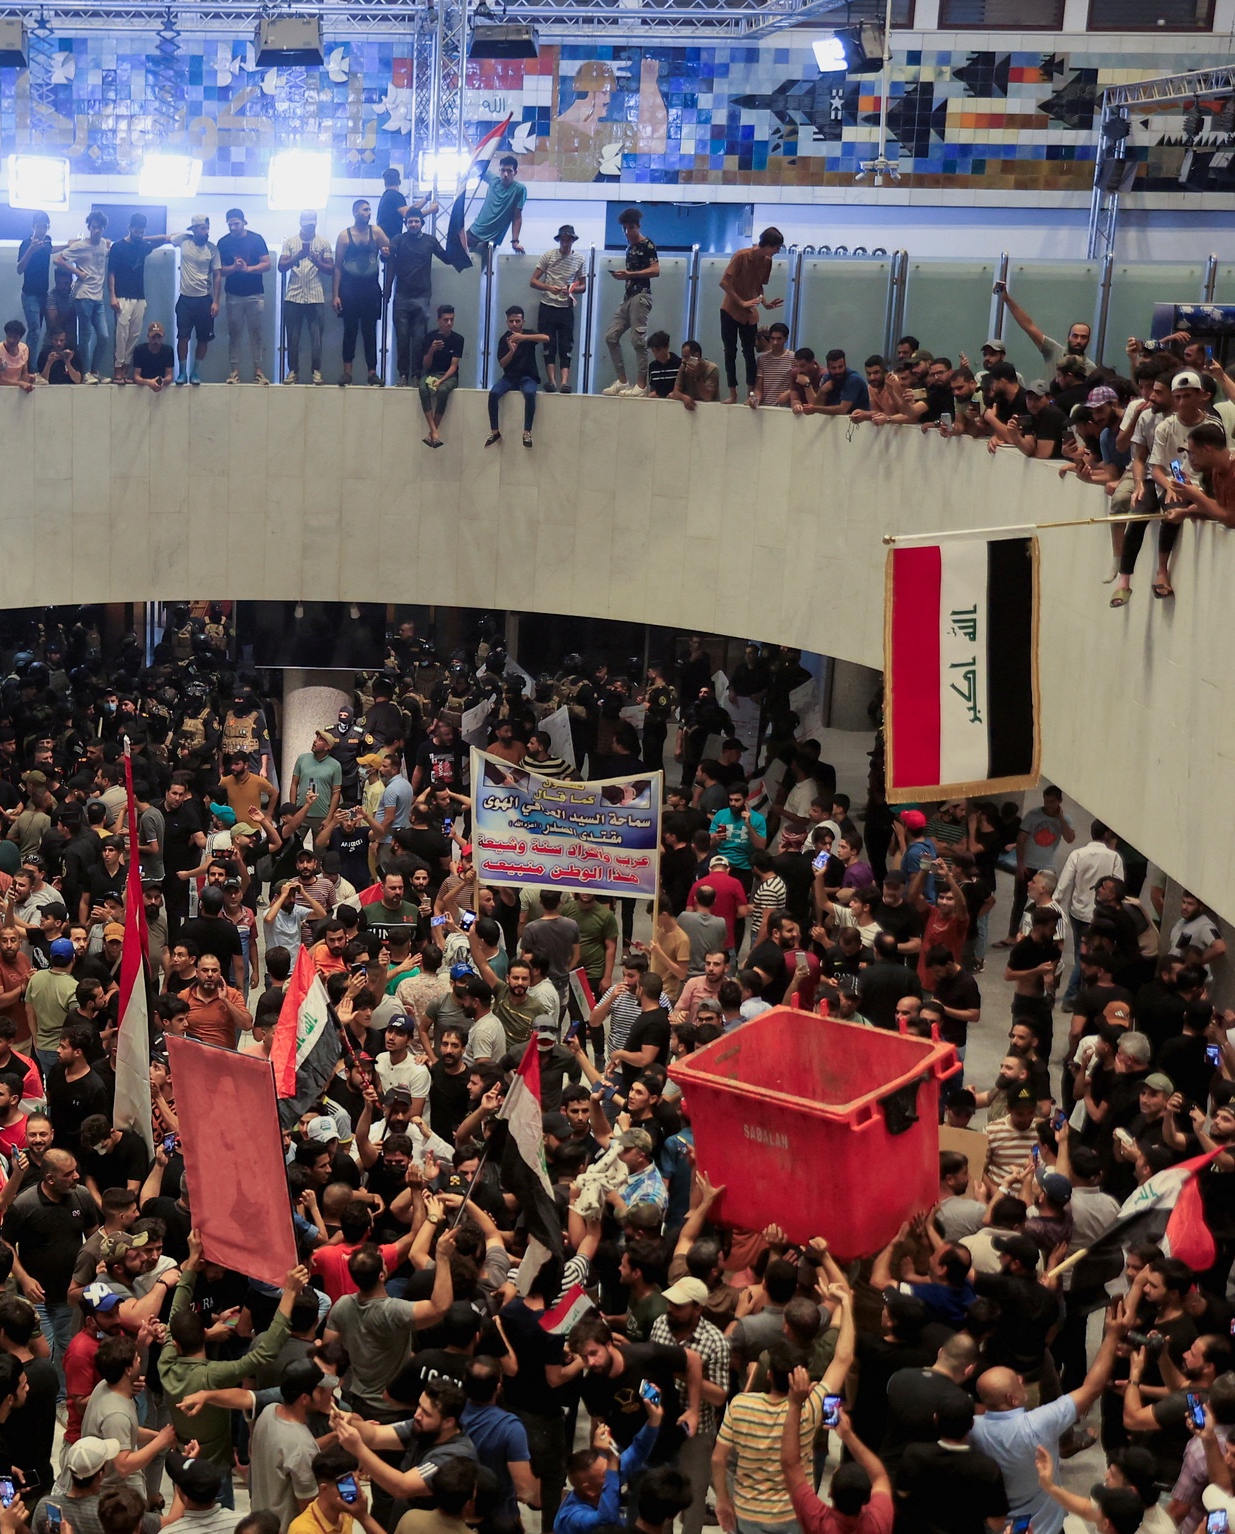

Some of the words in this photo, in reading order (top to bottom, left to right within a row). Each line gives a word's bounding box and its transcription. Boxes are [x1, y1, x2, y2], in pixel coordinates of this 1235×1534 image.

[482, 97, 505, 113] الله
[534, 789, 566, 802] قال
[570, 793, 596, 804] كما
[483, 796, 518, 811] الهوى
[569, 813, 605, 827] السيد
[609, 812, 651, 828] سماحة
[477, 835, 526, 854] وشيعة
[580, 831, 622, 844] مقتدى
[531, 839, 563, 854] سنة
[482, 860, 545, 876] منبيعه
[615, 856, 649, 869] عرب
[550, 864, 603, 881] الوطن
[606, 868, 639, 884] هذا
[743, 1124, 789, 1149] SABALAN
